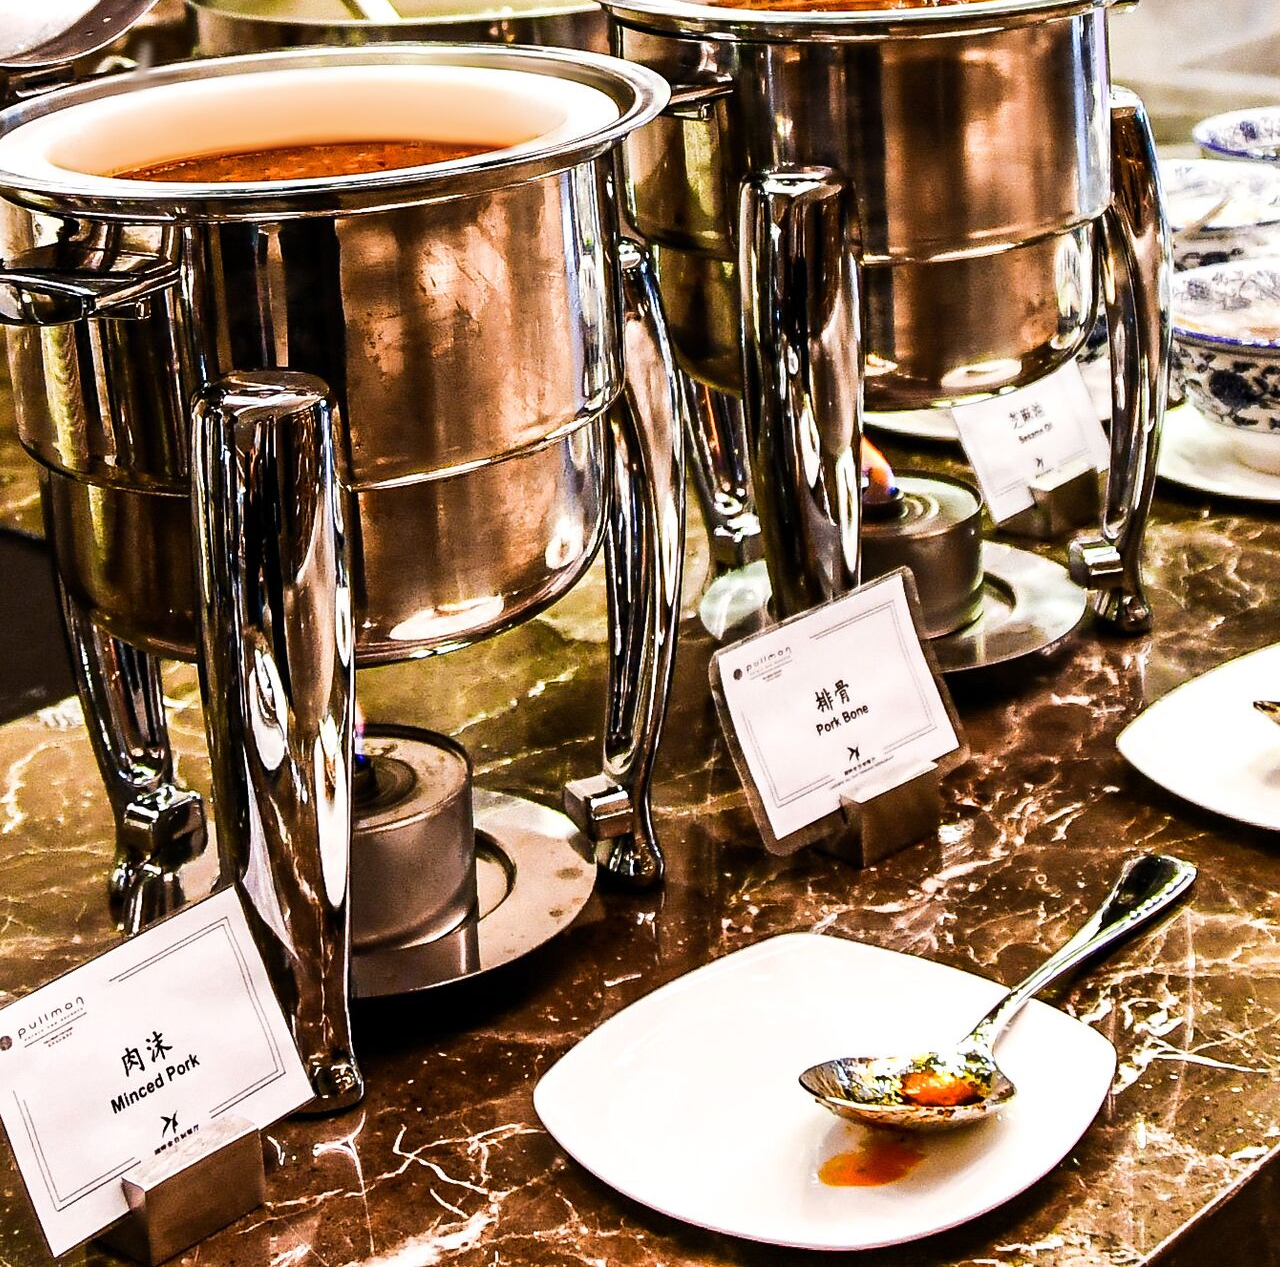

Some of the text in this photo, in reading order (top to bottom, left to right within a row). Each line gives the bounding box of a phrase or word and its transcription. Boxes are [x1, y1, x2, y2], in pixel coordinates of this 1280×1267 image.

[815, 679, 850, 712] 排骨
[816, 705, 869, 736] Pork Bone
[122, 1031, 173, 1077] 肉沫
[110, 1053, 201, 1114] Minced Pork
